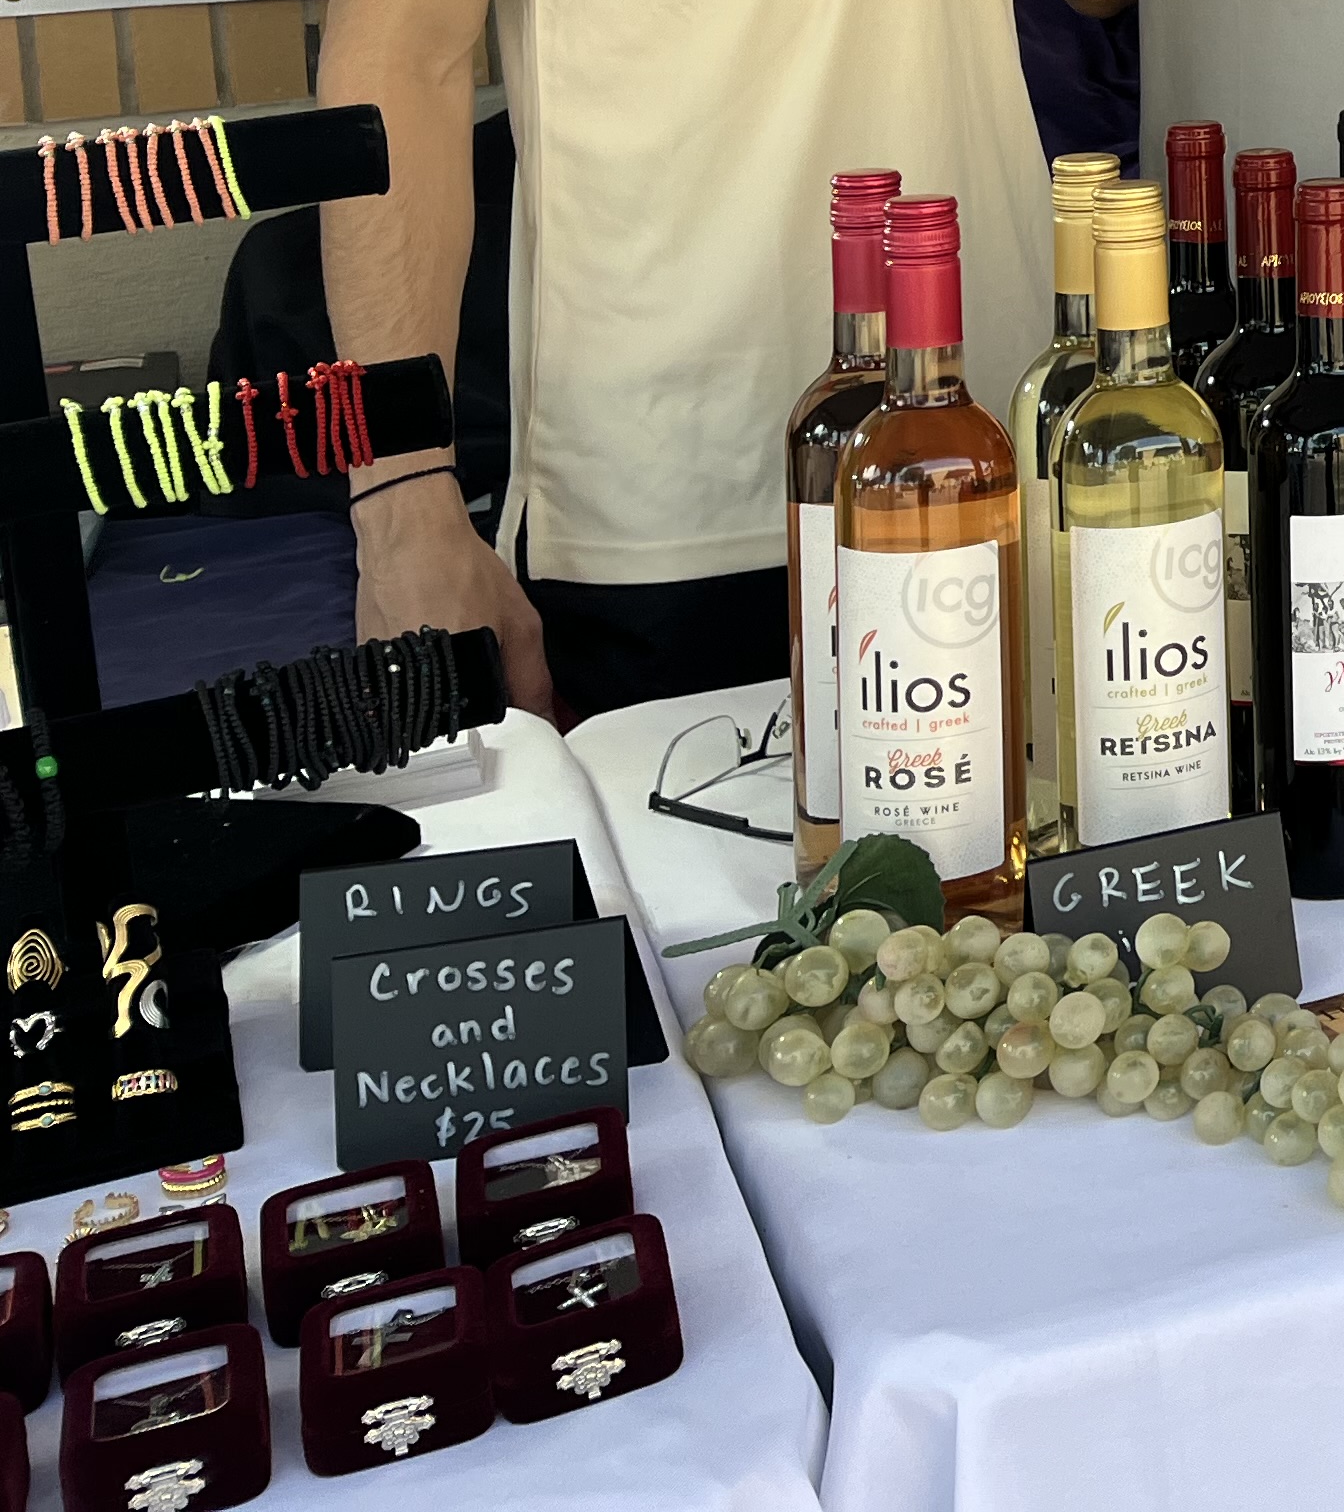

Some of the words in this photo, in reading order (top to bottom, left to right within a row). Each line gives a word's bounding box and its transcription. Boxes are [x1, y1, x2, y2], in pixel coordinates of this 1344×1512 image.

[862, 718, 908, 732] crafted
[929, 712, 970, 733] greek
[1100, 721, 1217, 756] RETSINA
[1137, 709, 1188, 739] Greek
[865, 753, 972, 790] ROSÉ
[888, 748, 943, 776] Greek
[1122, 769, 1170, 782] RETSINA
[1175, 760, 1202, 775] WINE
[874, 806, 910, 817] ROSÉ
[920, 802, 960, 815] WINE
[345, 877, 533, 922] RINGS
[1052, 850, 1255, 914] GREEK
[369, 958, 576, 1002] Crosses
[431, 1005, 517, 1049] and
[356, 1052, 611, 1109] Necklaces
[434, 1106, 516, 1147] $25
